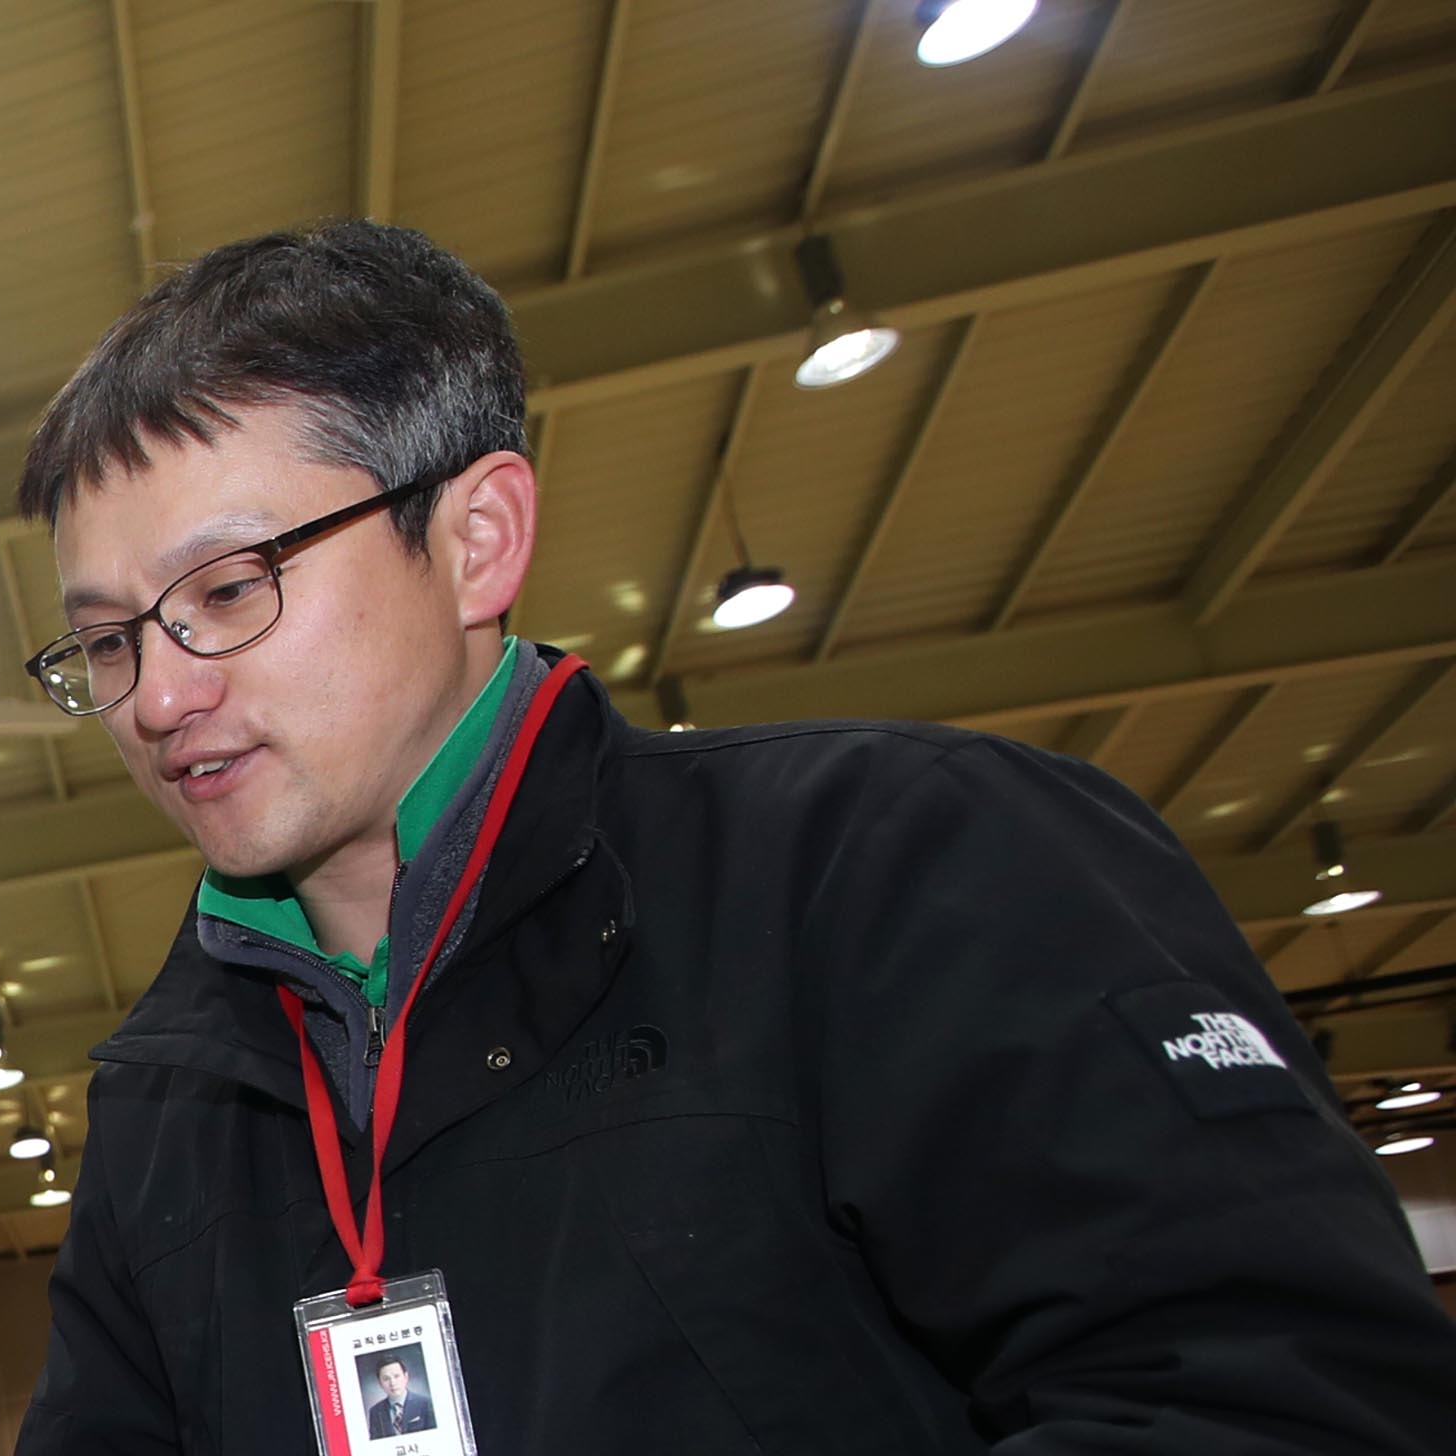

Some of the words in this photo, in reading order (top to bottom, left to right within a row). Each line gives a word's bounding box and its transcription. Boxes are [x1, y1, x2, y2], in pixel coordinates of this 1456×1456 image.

[1190, 1012, 1240, 1033] THE
[1162, 1030, 1256, 1061] NORTH
[1202, 1048, 1266, 1071] FACE
